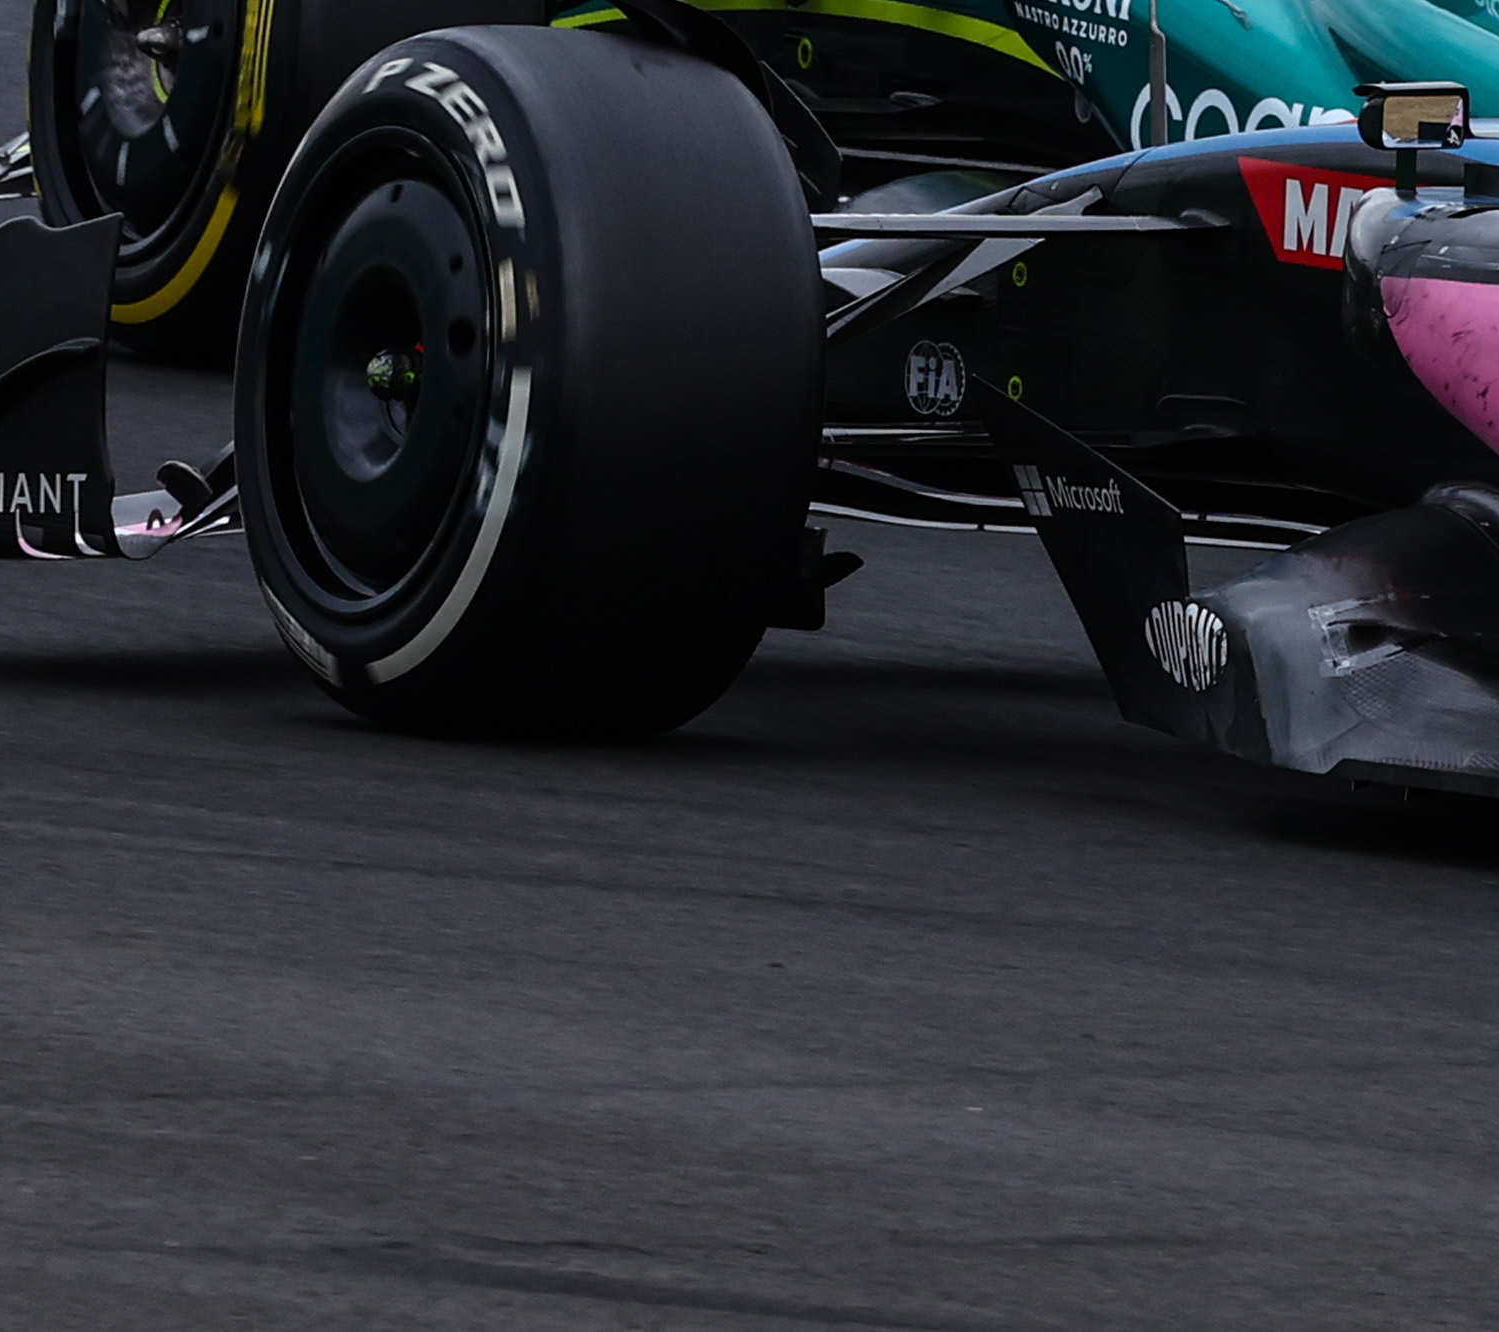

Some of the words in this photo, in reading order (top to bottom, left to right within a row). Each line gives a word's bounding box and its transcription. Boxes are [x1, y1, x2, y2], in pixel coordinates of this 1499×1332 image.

[1014, 2, 1059, 30] NASTRO
[1062, 16, 1128, 47] AZZURRO
[361, 57, 414, 94] P
[1045, 476, 1125, 515] Microsoft
